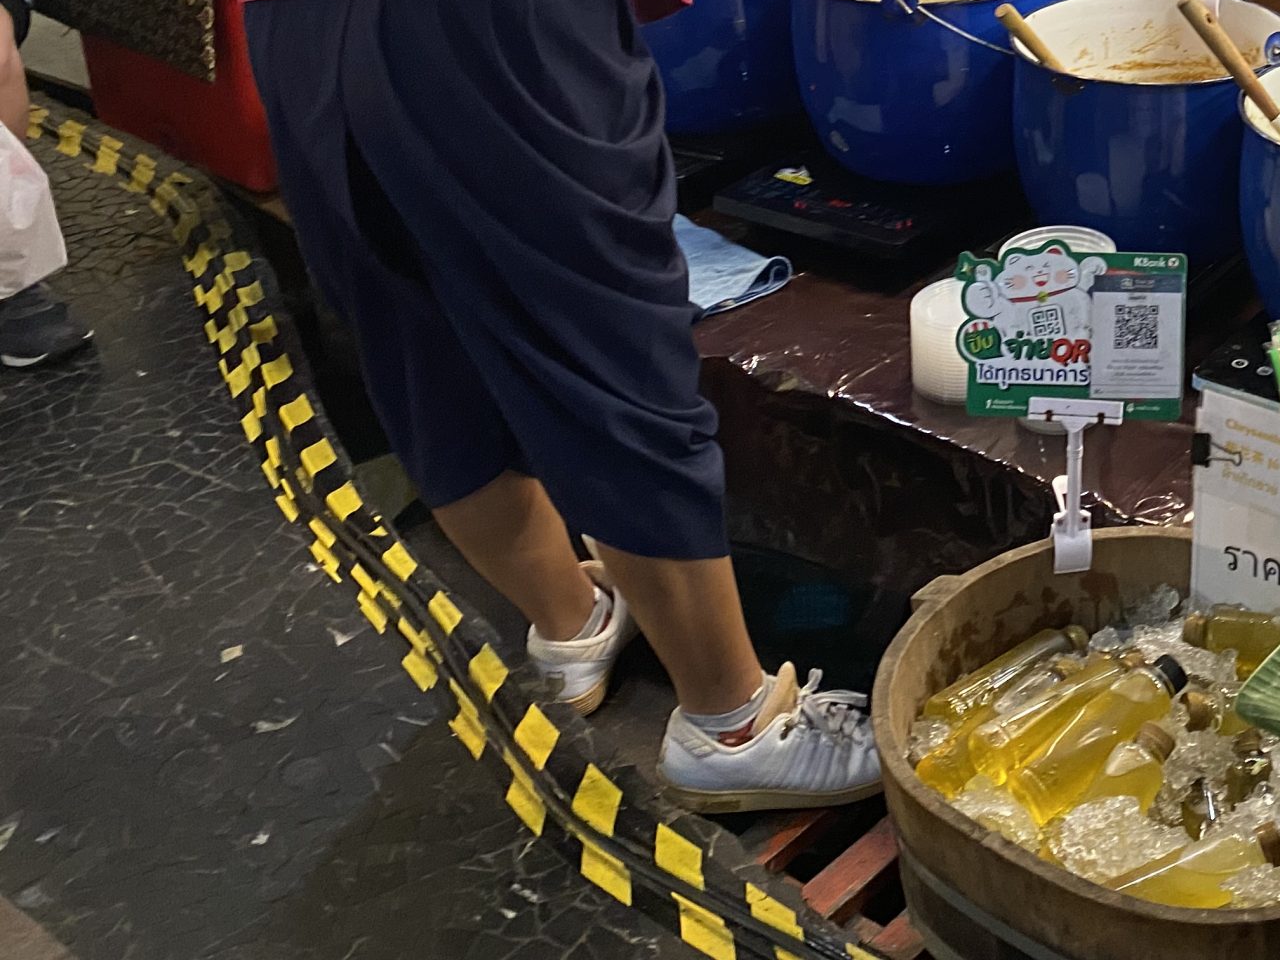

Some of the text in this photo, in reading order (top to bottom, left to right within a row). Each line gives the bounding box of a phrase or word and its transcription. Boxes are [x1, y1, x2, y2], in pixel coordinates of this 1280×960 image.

[1133, 257, 1166, 268] KBank
[978, 363, 1089, 386] ได้ทุกธนาคาร
